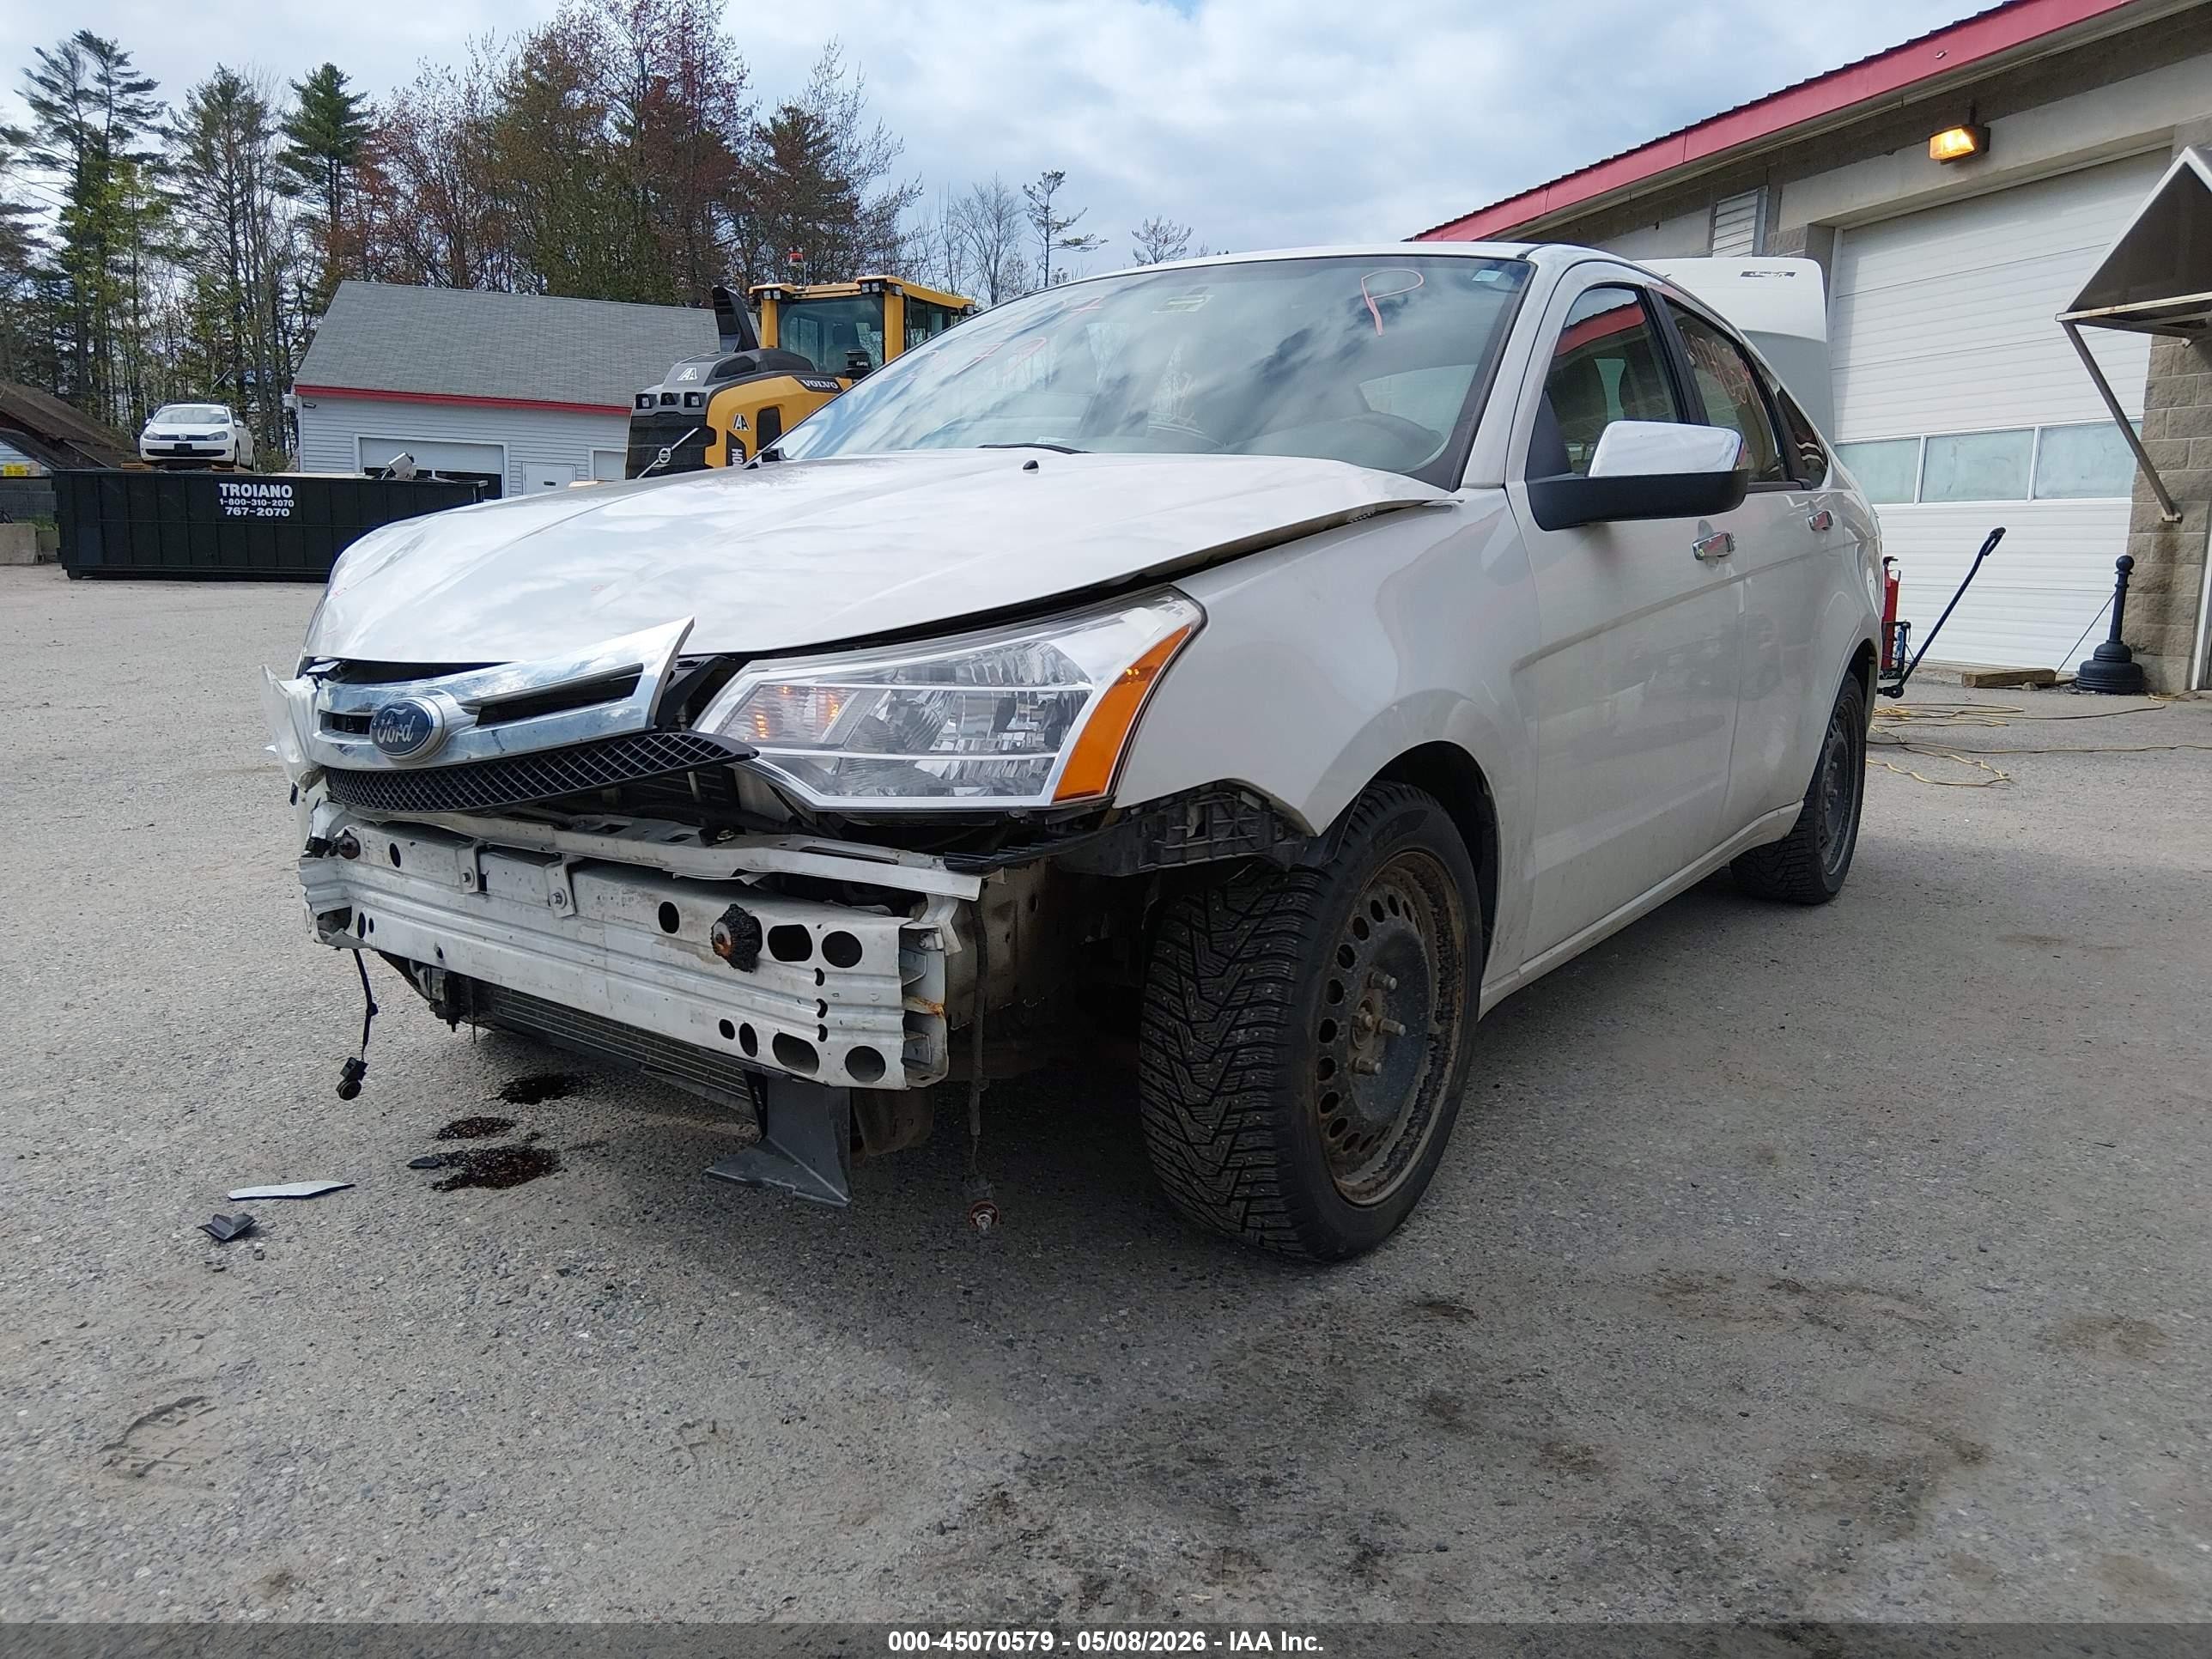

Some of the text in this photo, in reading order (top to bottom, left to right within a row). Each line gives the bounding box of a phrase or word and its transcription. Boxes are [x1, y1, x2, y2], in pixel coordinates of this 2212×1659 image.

[800, 379, 839, 389] VOLVO
[219, 483, 293, 498] TROIANO
[219, 498, 295, 507] 1-800-310-2070
[225, 507, 290, 517] 767-2070
[378, 708, 416, 744] Ford
